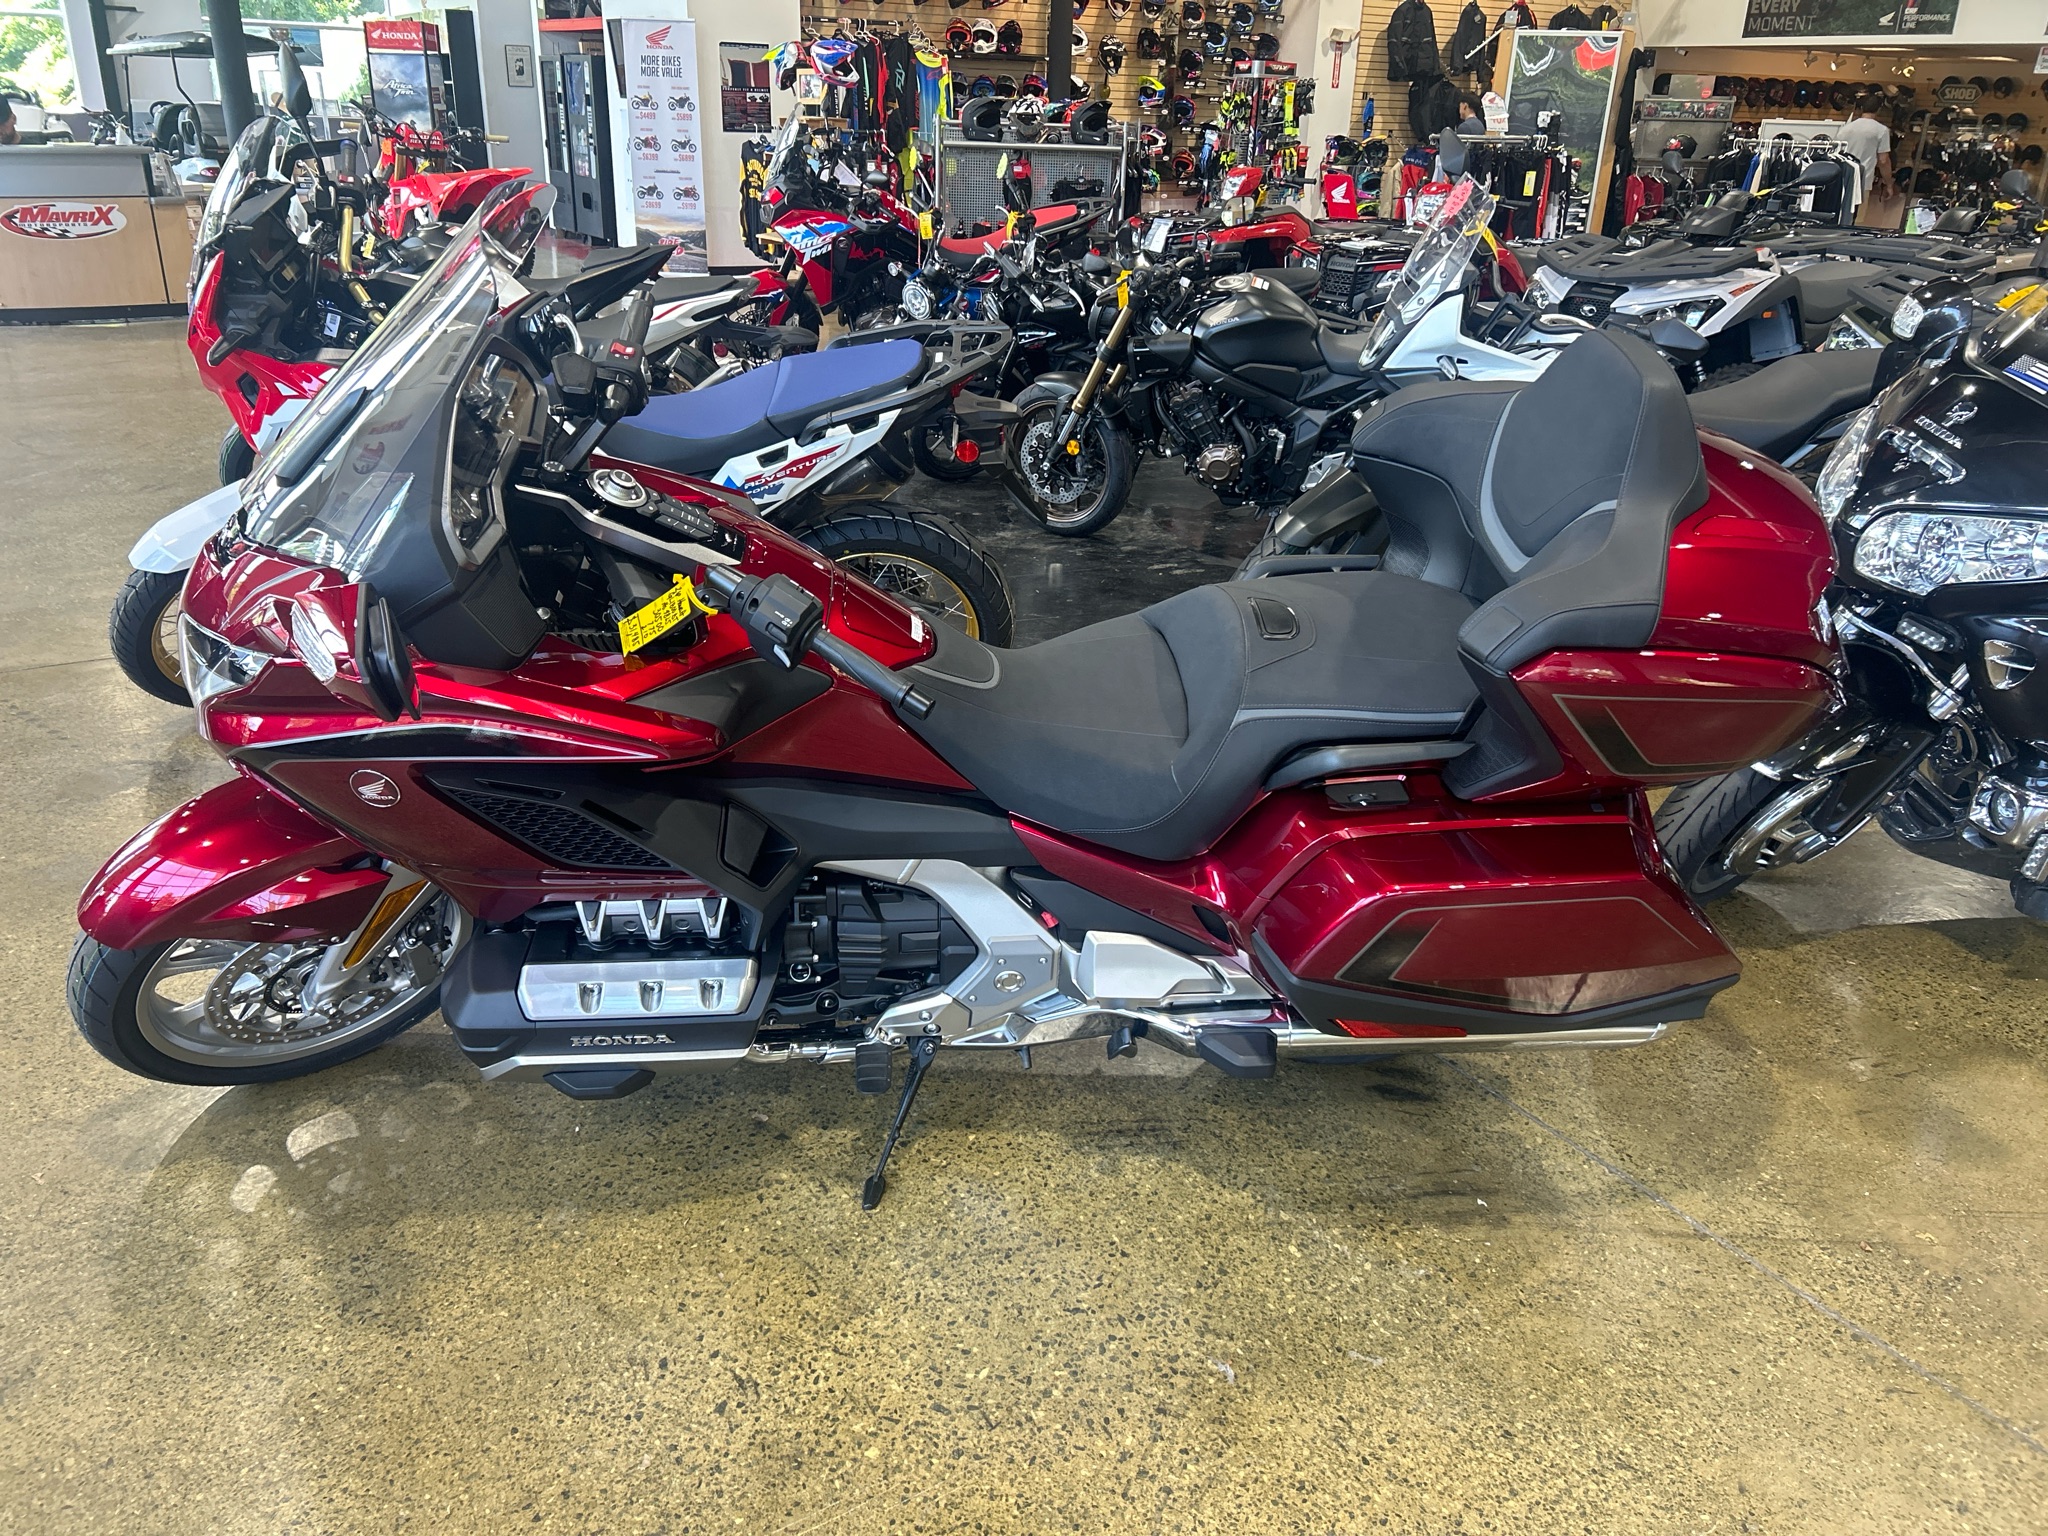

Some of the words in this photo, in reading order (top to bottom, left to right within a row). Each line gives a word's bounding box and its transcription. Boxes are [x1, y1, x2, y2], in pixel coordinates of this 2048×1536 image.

[1749, 0, 1800, 14] EVERY
[1747, 15, 1817, 32] MOMENT
[1903, 14, 1951, 22] PERFORMANCE
[1902, 21, 1918, 29] LINE
[381, 31, 418, 40] HONDA
[641, 55, 660, 66] MORE
[661, 55, 681, 67] BIKES
[641, 66, 660, 78] MORE
[661, 67, 683, 79] VALUE
[384, 79, 413, 89] Africa
[1943, 87, 1977, 100] SHOEI
[1209, 316, 1240, 328] HONDA
[1914, 414, 1962, 450] HONDA
[744, 451, 837, 490] ADVENTURE
[570, 1033, 676, 1047] HONDA
